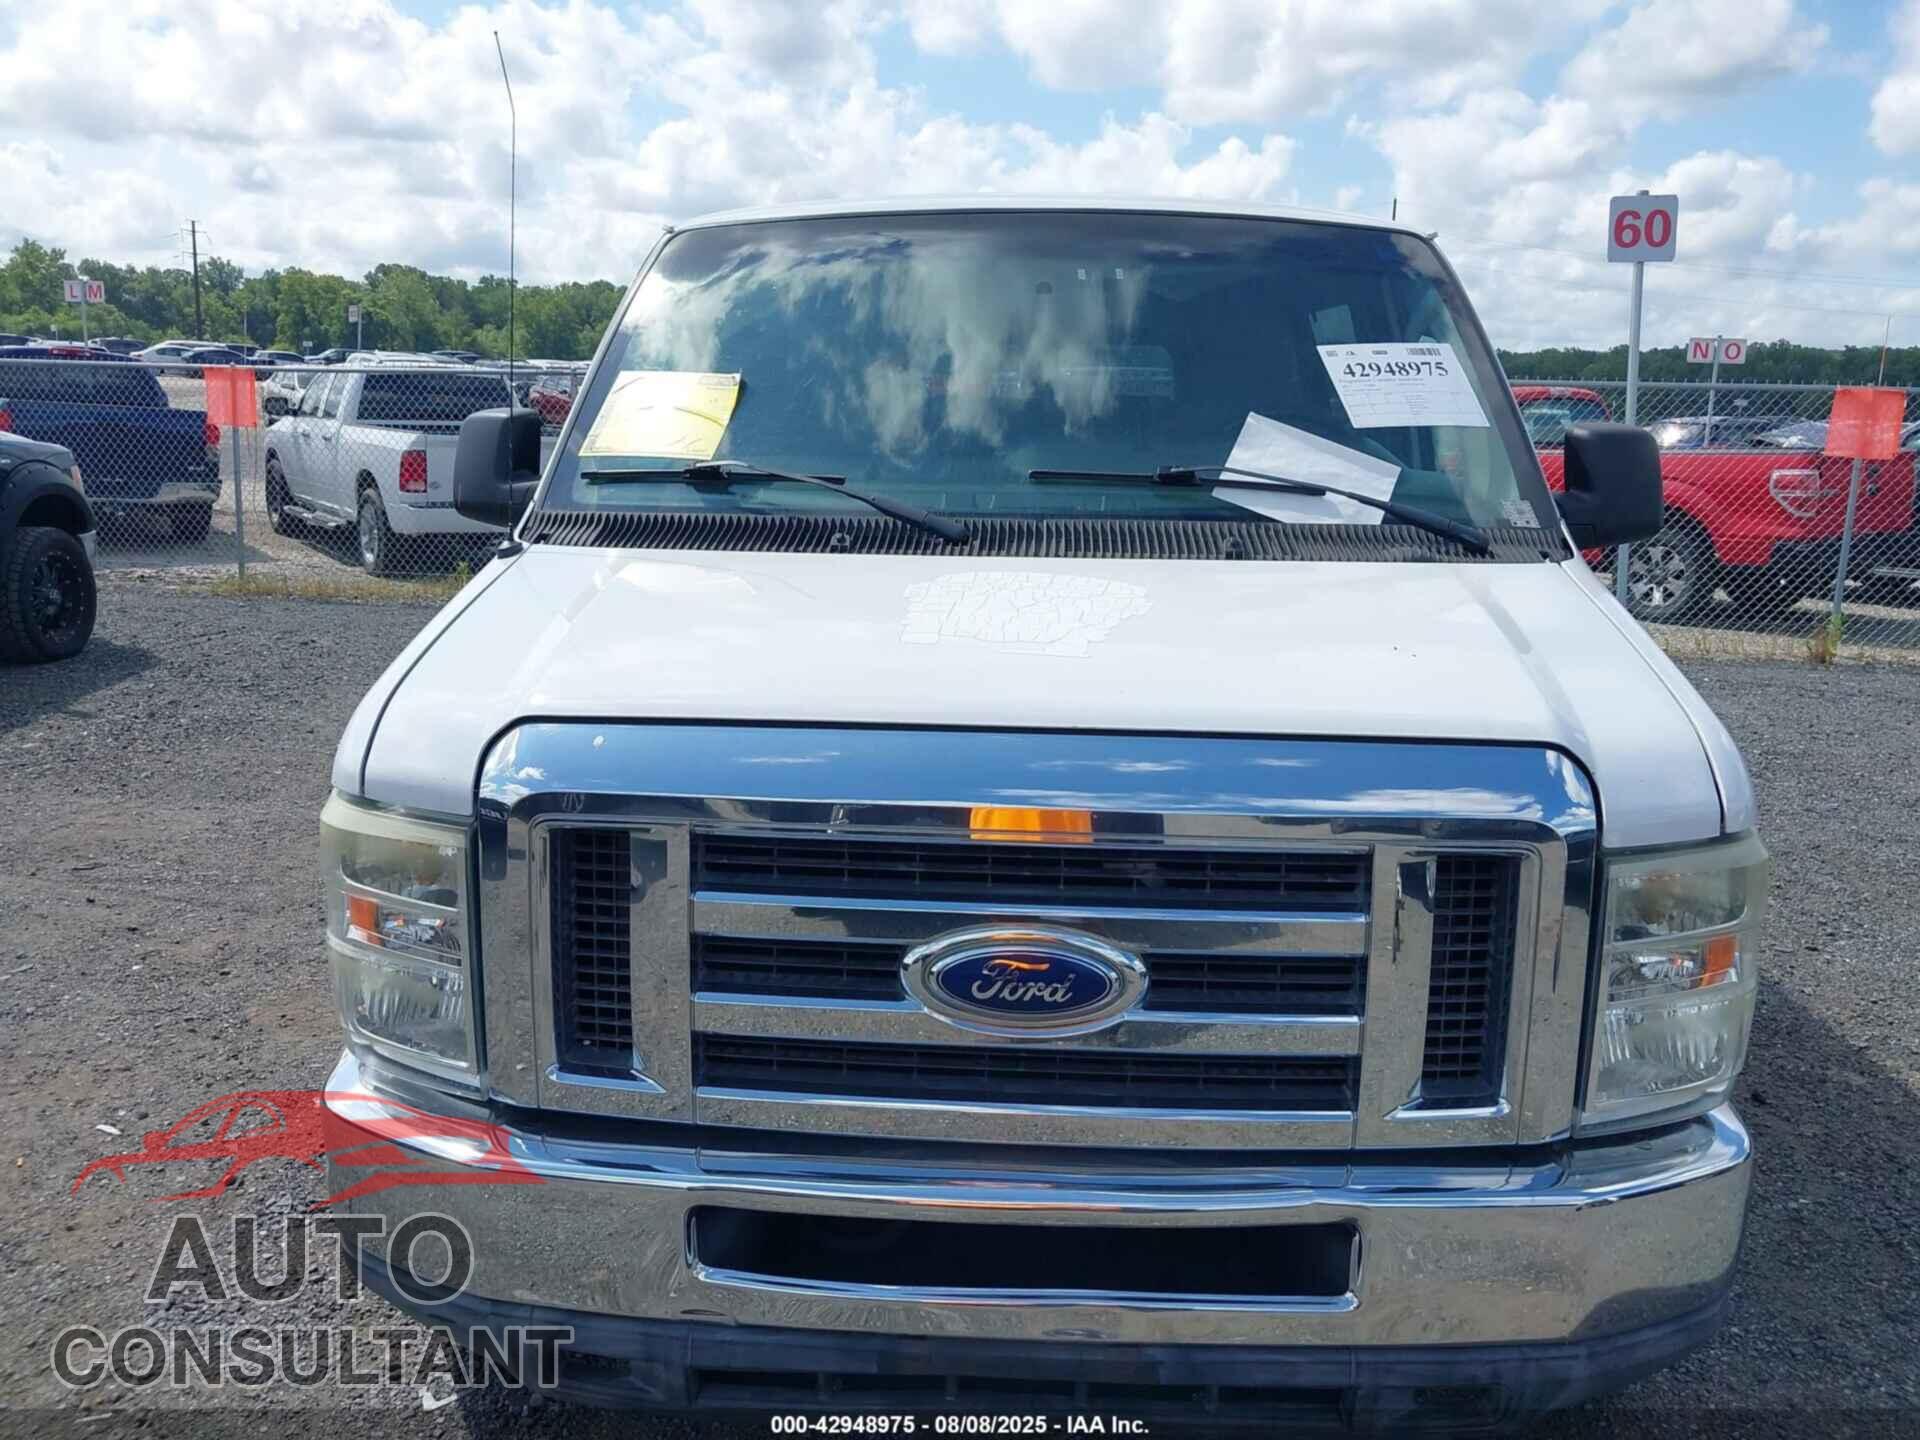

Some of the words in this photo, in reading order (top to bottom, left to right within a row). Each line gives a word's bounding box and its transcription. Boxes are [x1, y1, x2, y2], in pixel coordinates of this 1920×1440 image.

[1614, 209, 1671, 248] 60
[87, 284, 103, 299] M
[1692, 341, 1709, 359] N
[1724, 342, 1741, 360] O
[1343, 361, 1448, 378] 42948975
[970, 959, 1076, 1003] Ford
